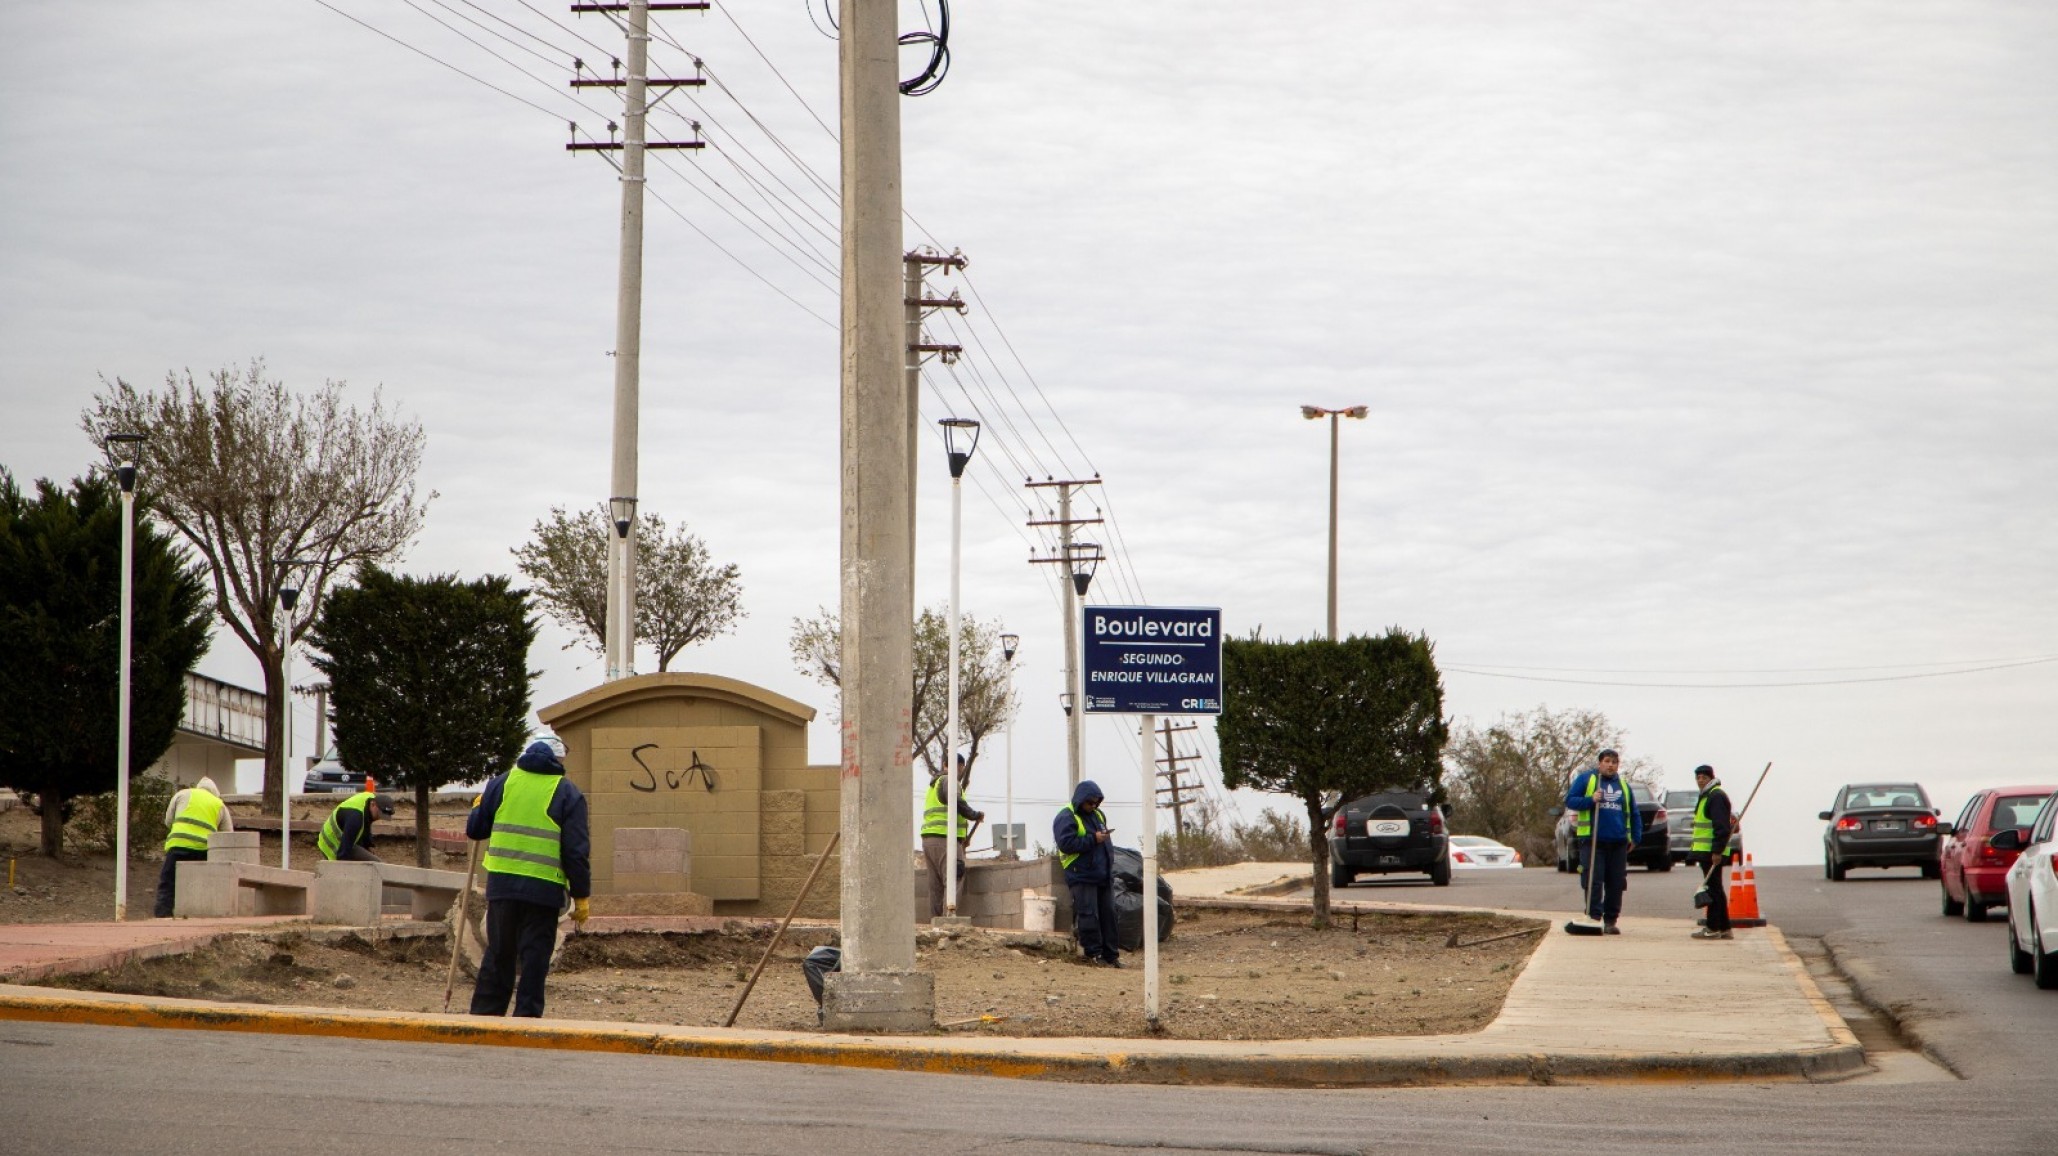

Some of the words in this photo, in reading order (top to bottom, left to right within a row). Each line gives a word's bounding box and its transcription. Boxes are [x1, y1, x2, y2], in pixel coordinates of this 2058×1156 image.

[1095, 616, 1212, 637] Boulevard
[1122, 653, 1183, 665] SEGUNDO
[1091, 671, 1143, 683] ENRIQUE
[1146, 672, 1214, 683] VILLAGRAN
